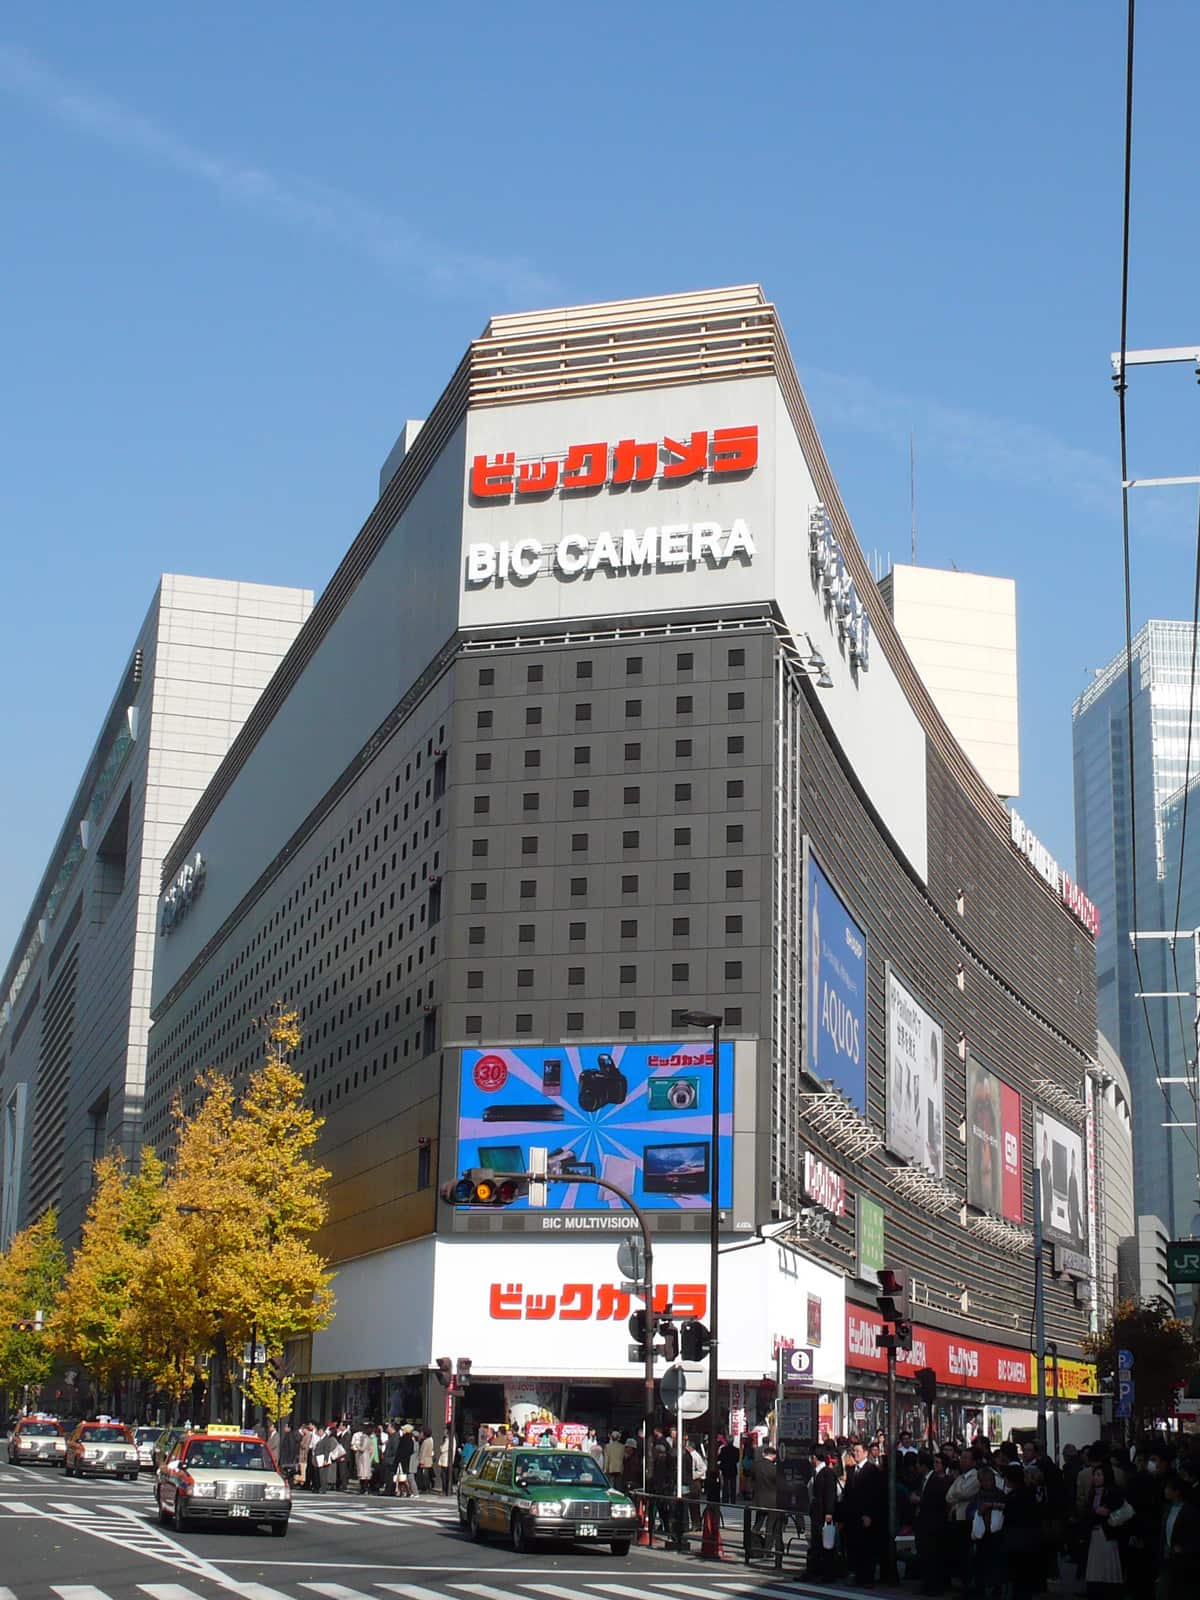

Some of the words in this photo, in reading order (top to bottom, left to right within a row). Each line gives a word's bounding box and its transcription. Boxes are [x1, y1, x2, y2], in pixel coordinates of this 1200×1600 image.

[472, 425, 758, 497] ビックカメラ
[469, 540, 543, 580] BIC
[556, 518, 757, 572] CAMERA
[822, 980, 860, 1064] AQUOS
[542, 1217, 561, 1229] BIC
[565, 1217, 639, 1229] MULTIVISION
[1174, 1254, 1200, 1269] JR
